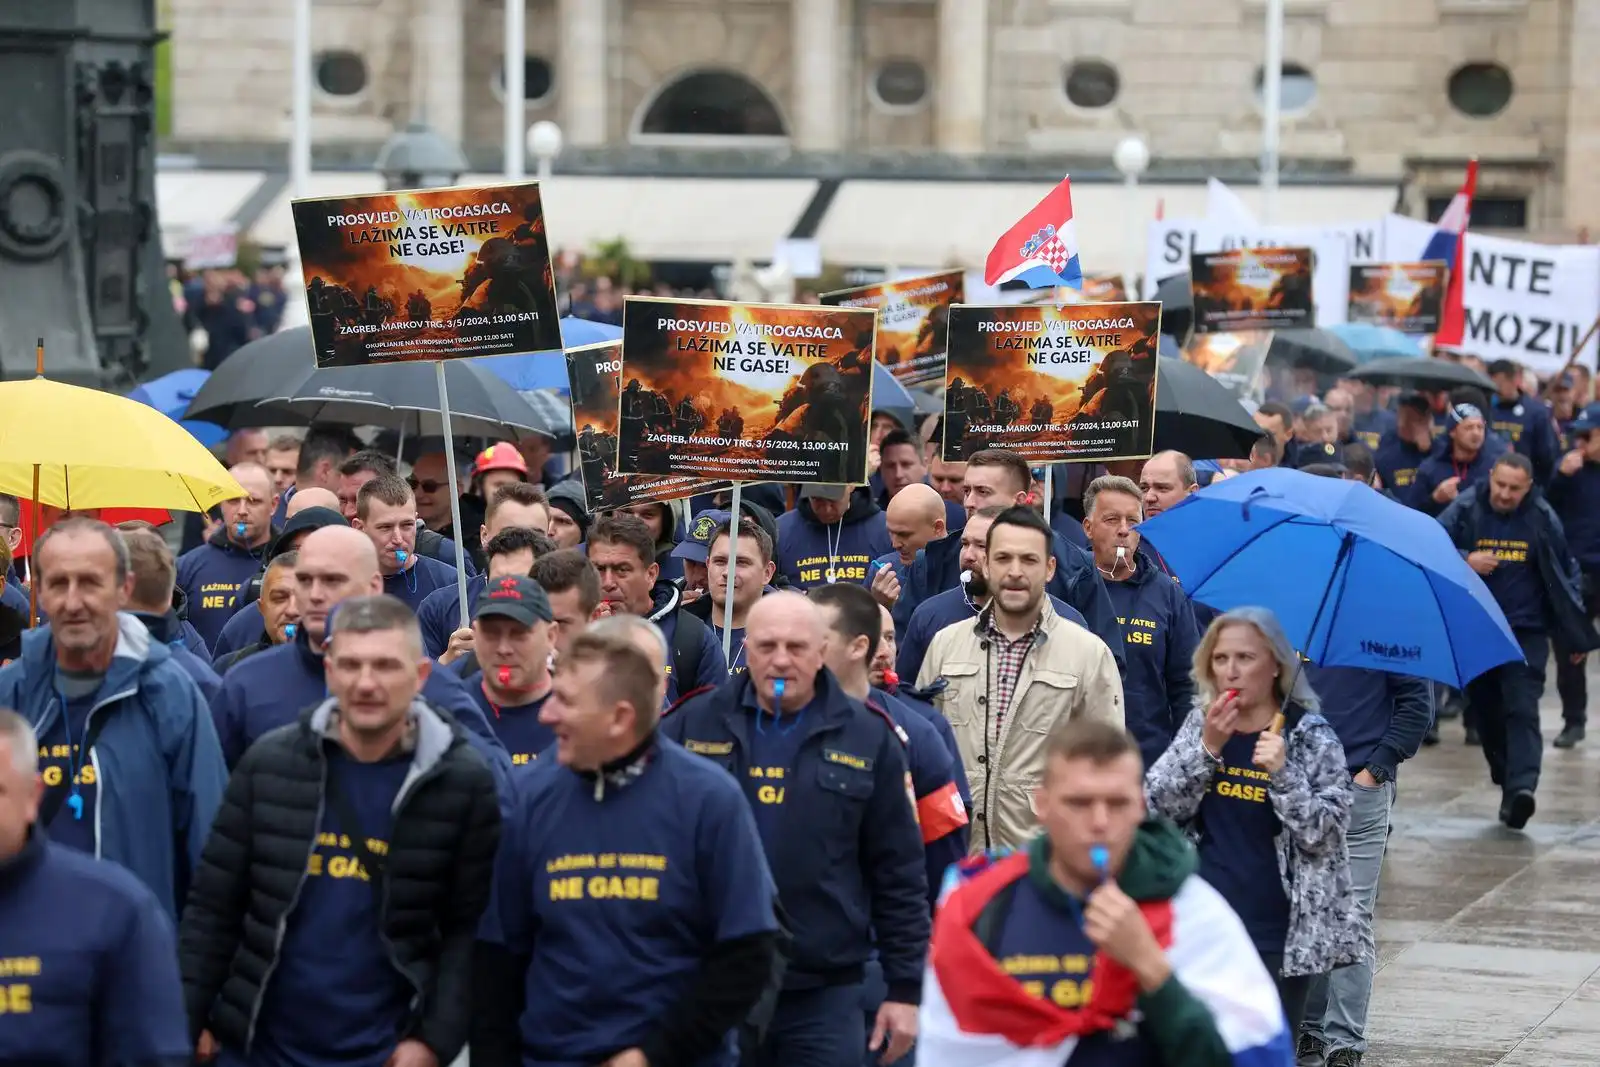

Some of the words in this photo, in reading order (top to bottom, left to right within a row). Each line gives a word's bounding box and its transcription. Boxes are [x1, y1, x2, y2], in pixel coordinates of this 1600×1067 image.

[327, 211, 399, 227] PROSVJED
[401, 202, 512, 221] VATROGASACA
[350, 226, 416, 244] LAŽIMA
[420, 225, 439, 239] SE
[442, 220, 499, 237] VATRE
[390, 242, 413, 257] NE
[416, 239, 465, 256] GASE!
[340, 324, 380, 335] ZAGREB,
[381, 320, 424, 331] MARKOV
[425, 319, 446, 330] TRG,
[447, 316, 491, 329] 3/5/2024,
[492, 313, 516, 325] 13,00
[518, 311, 539, 321] SATI
[657, 318, 731, 334] PROSVJED
[733, 322, 843, 340] VATROGASACA
[978, 321, 1043, 333] PROSVJED
[1044, 318, 1134, 331] VATROGASACA
[365, 341, 404, 349] OKUPLJANJE
[416, 338, 454, 346] EUROPSKOM
[677, 336, 743, 355] LAŽIMA
[747, 341, 767, 356] SE
[771, 342, 828, 358] VATRE
[995, 334, 1053, 350] LAŽIMA
[1056, 336, 1072, 348] SE
[1075, 334, 1122, 347] VATRE
[1027, 352, 1047, 364] NE
[1050, 350, 1091, 364] GASE!
[714, 356, 736, 371] NE
[740, 358, 789, 374] GASE!
[969, 424, 1005, 433] ZAGREB,
[1006, 423, 1042, 432] MARKOV
[1063, 421, 1100, 432] 3/5/2024,
[1101, 420, 1121, 430] 13,00
[1121, 420, 1139, 429] SATI
[647, 433, 687, 445] ZAGREB,
[688, 436, 732, 448] MARKOV
[733, 438, 754, 449] TRG,
[756, 439, 800, 451] 3/5/2024,
[802, 441, 826, 451] 13,00
[828, 441, 849, 451] SATI
[669, 454, 708, 463] OKUPLJANJE
[720, 457, 759, 465] EUROPSKOM
[628, 481, 660, 491] OKUPLJANJE
[797, 556, 828, 567] LAŽIMA
[801, 569, 821, 582] NE
[201, 583, 233, 592] LAŽIMA
[203, 596, 225, 608] NE
[512, 753, 529, 765] SE
[766, 767, 784, 778] SE
[1242, 769, 1270, 781] VATR
[1217, 781, 1267, 803] GASE
[550, 876, 584, 901] NE
[588, 876, 659, 900] GASE
